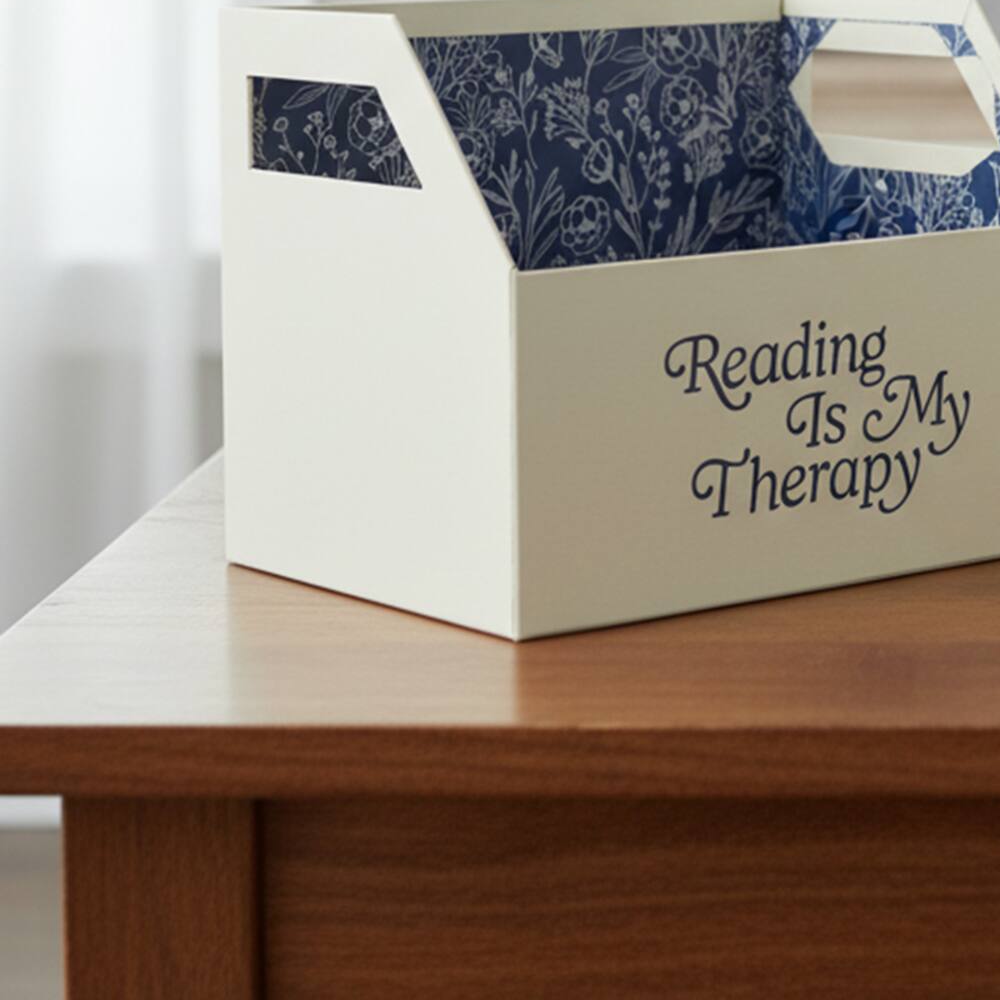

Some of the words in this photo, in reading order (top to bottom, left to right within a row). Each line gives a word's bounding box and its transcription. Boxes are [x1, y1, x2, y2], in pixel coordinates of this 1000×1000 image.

[664, 320, 887, 411] Reading
[786, 391, 847, 448] Is
[862, 370, 970, 456] My
[691, 447, 921, 518] Therapy
